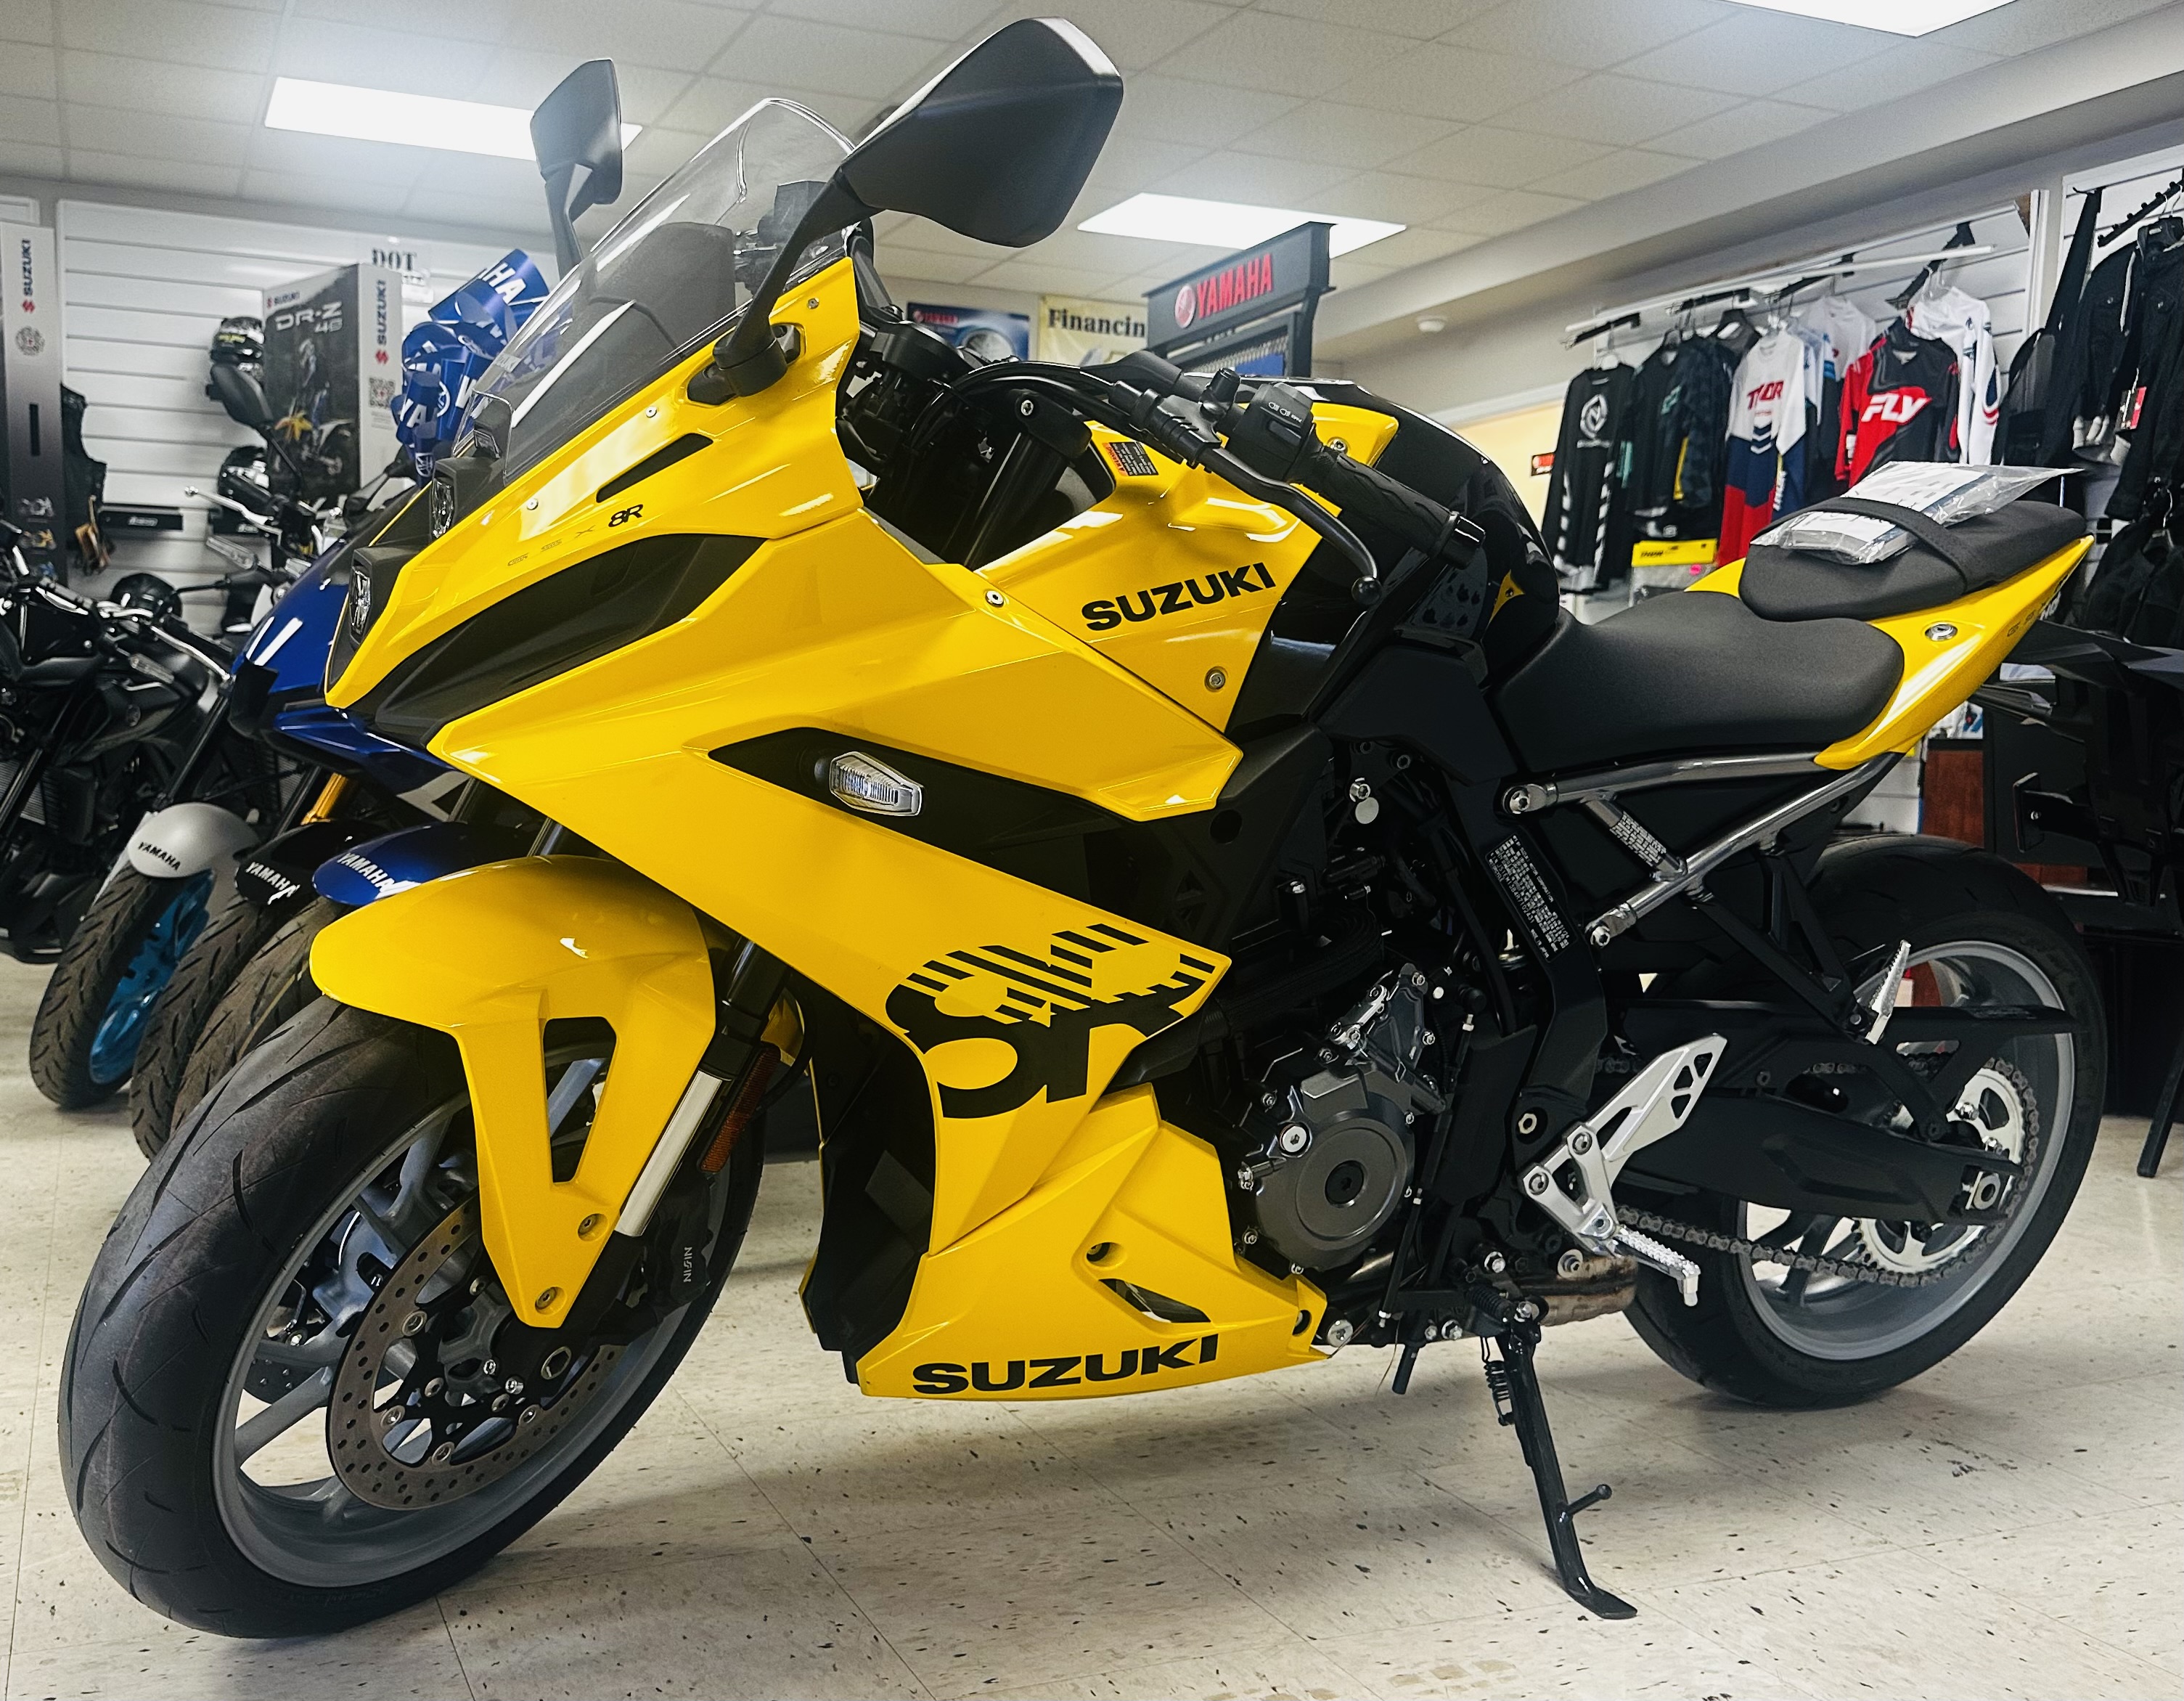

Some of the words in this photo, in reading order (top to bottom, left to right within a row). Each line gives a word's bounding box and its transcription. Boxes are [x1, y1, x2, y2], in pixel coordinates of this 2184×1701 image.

[1197, 253, 1272, 319] YAMAHA
[377, 280, 387, 346] SUZUKI
[1861, 393, 1931, 423] FLY
[608, 504, 643, 528] 8R
[1081, 562, 1277, 631] SUZUKI
[138, 841, 181, 870] YAMAHA
[336, 852, 403, 894] YAMAHA
[245, 861, 300, 898] YAMAHA
[912, 1334, 1219, 1395] SUZUKI
